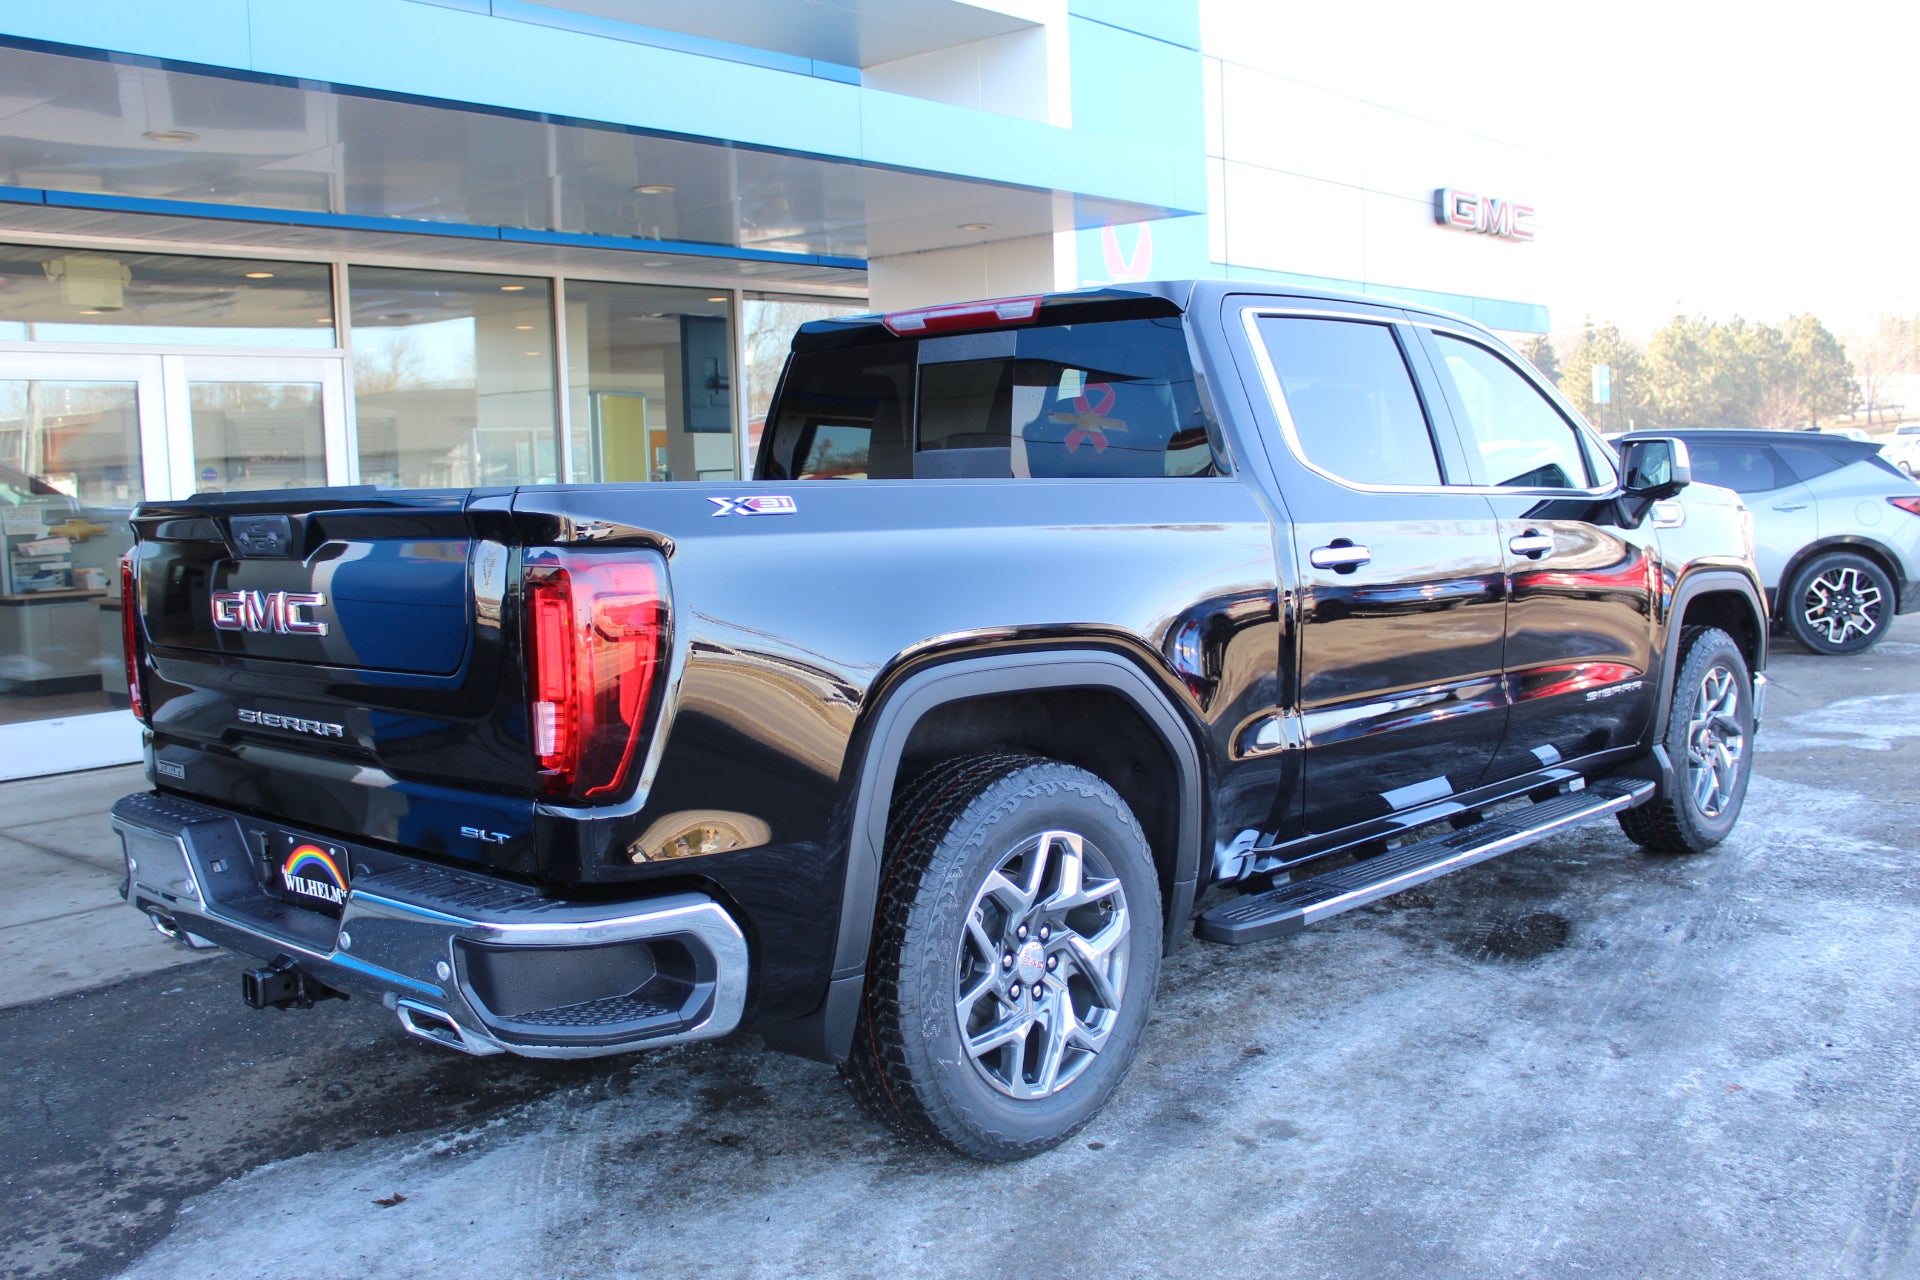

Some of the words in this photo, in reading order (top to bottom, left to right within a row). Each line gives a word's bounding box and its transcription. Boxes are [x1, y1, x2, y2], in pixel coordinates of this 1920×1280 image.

[1433, 187, 1534, 242] GMC
[211, 589, 329, 637] GMC
[1585, 680, 1642, 702] SIERRA
[237, 708, 344, 738] SIERRA
[460, 826, 511, 845] SLT
